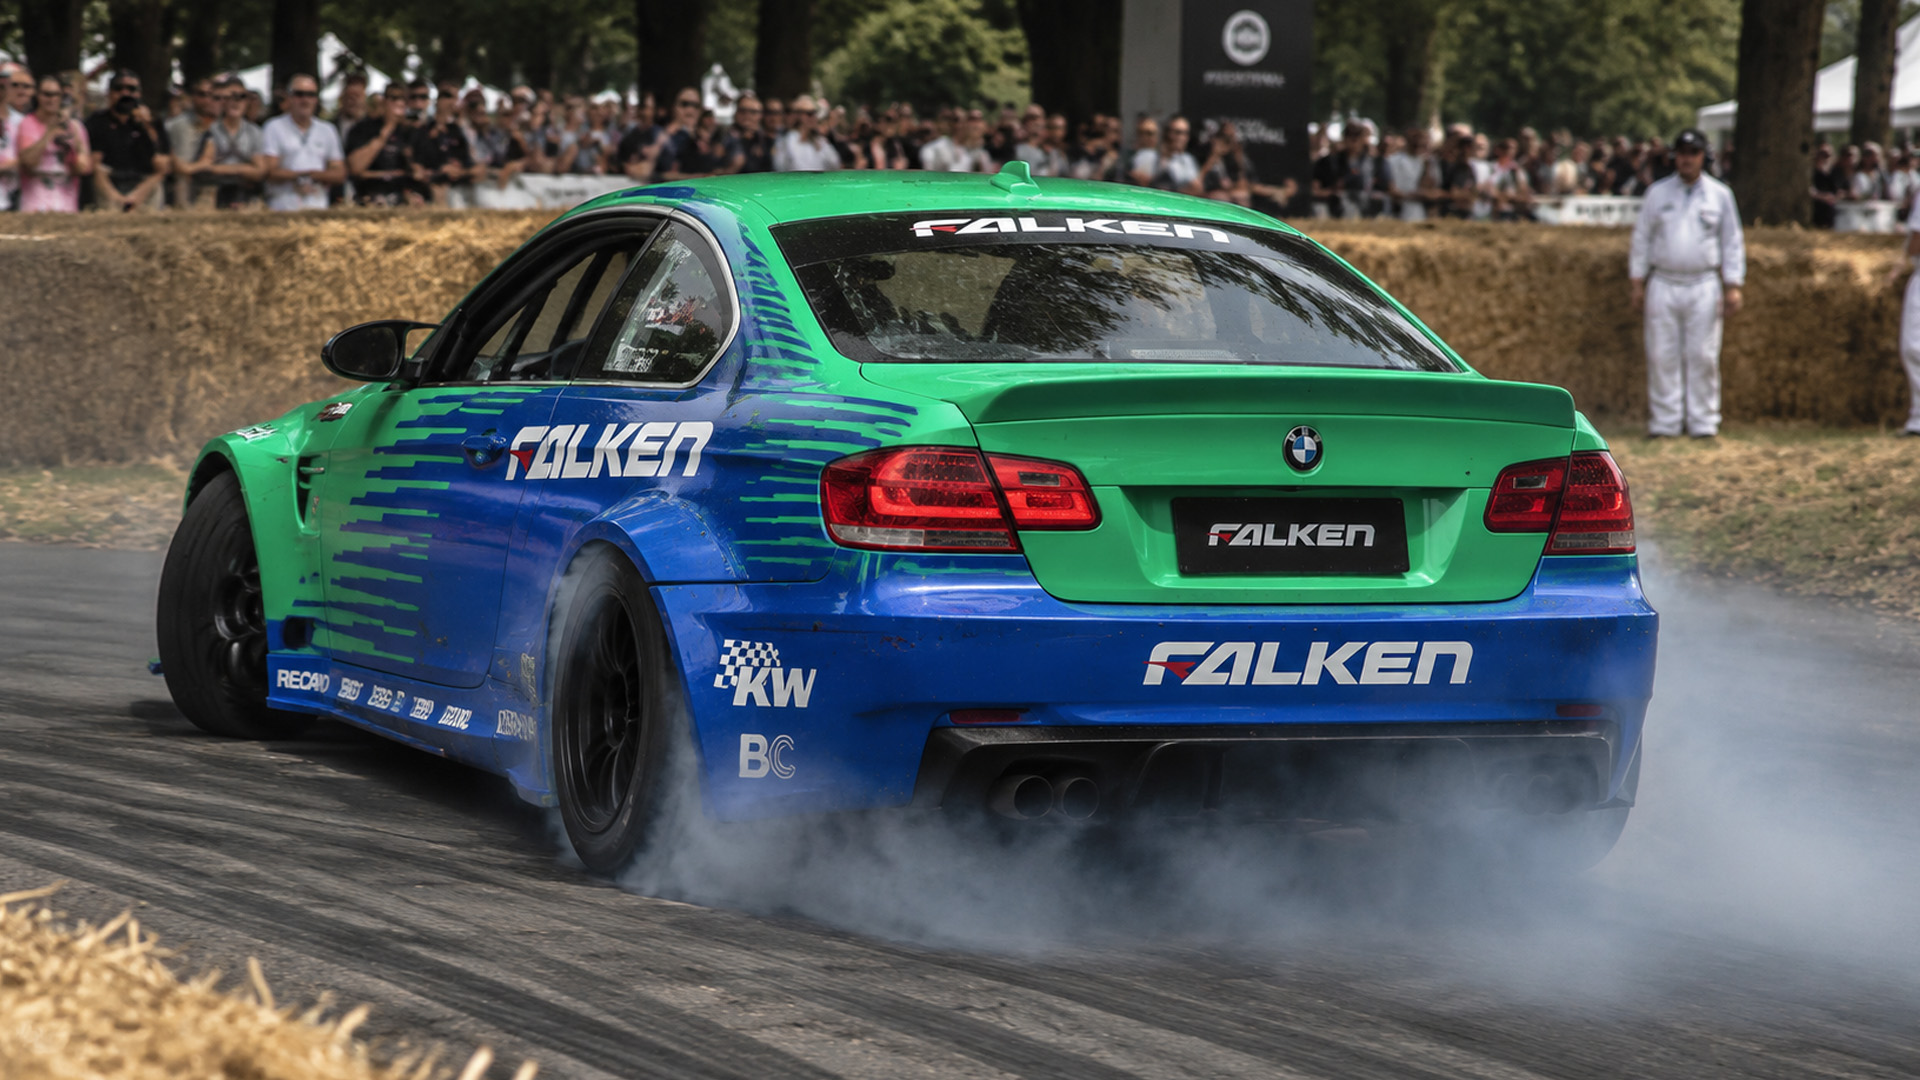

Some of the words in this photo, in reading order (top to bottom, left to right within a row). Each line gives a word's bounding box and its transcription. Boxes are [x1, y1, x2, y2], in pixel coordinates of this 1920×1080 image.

[910, 217, 1230, 244] FALKEN
[505, 421, 714, 480] FALKEN
[1207, 523, 1376, 547] FALKEN
[1143, 641, 1474, 685] FALKEN
[732, 665, 818, 708] KW
[738, 733, 796, 779] BC
